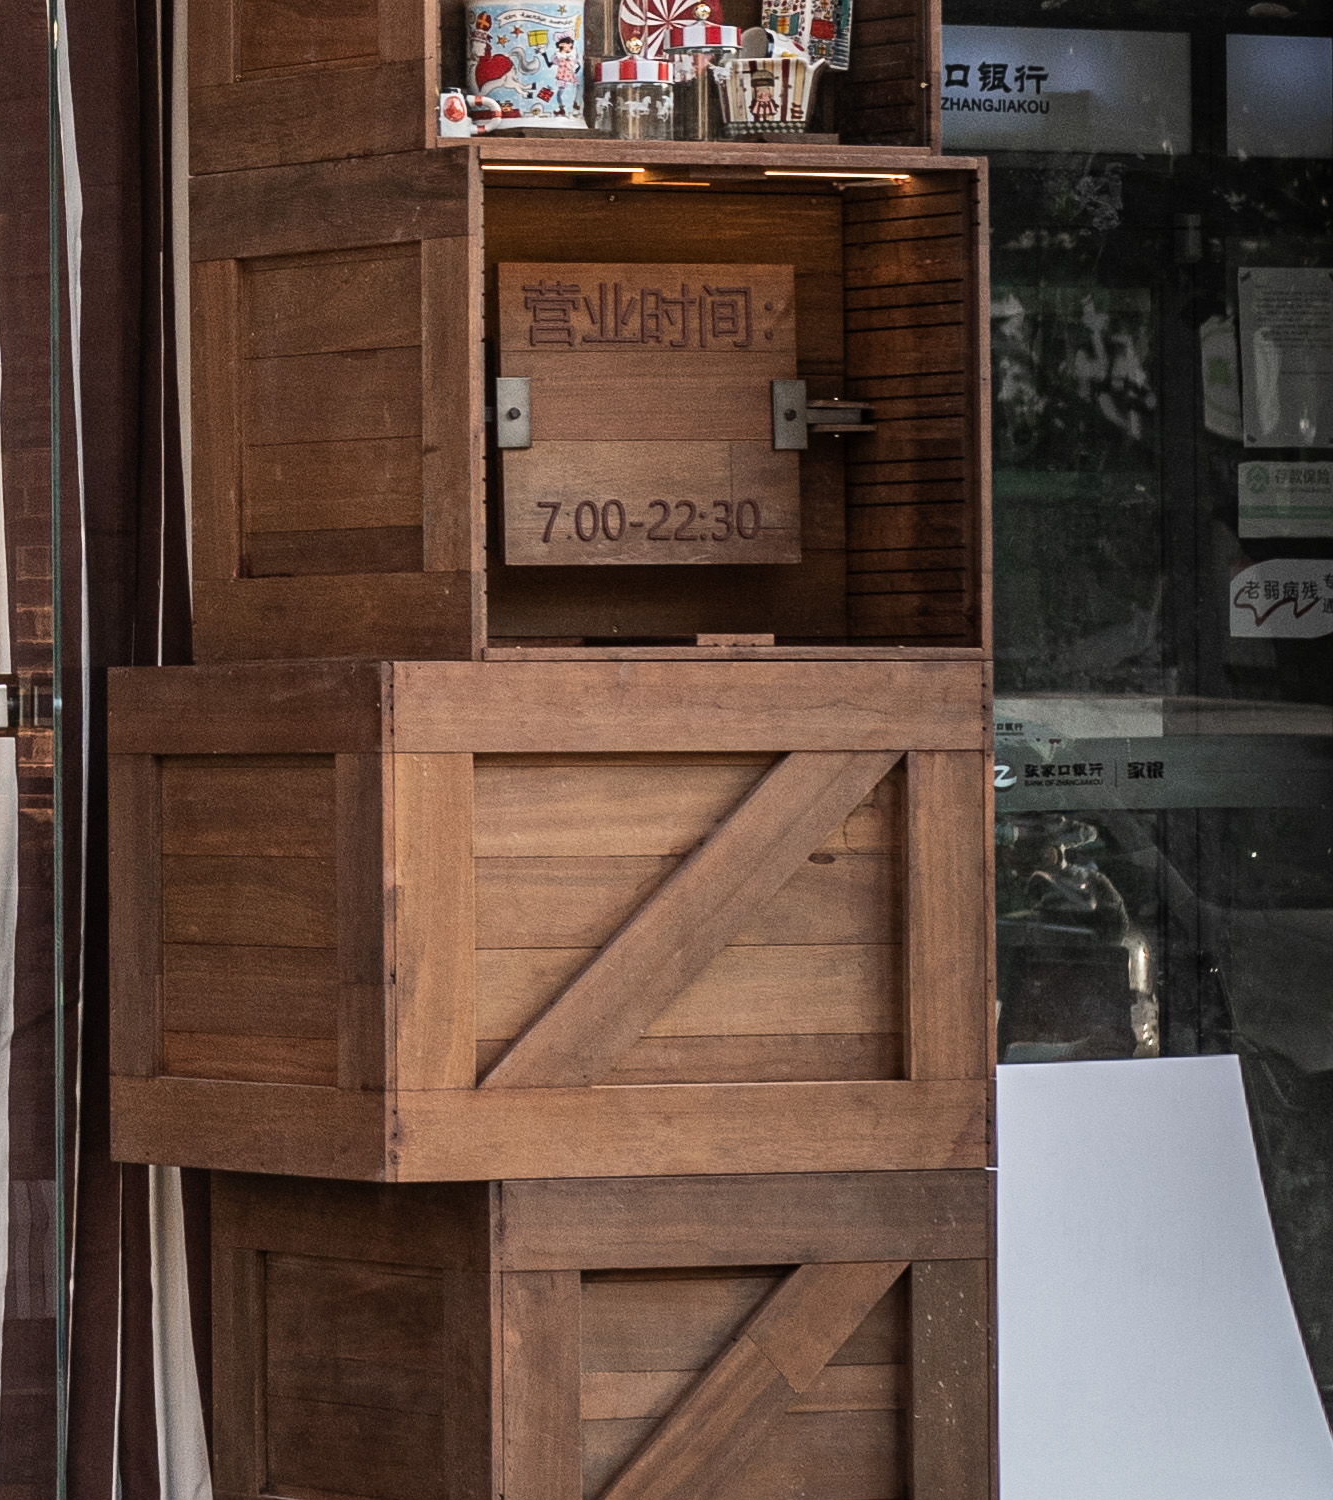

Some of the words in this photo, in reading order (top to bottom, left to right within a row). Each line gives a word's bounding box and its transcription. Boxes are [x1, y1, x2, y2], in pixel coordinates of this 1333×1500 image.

[944, 61, 1050, 95] 口银行
[941, 97, 1050, 115] ZHANGJIAKOU
[536, 498, 762, 544] 7:00-22:30
[1244, 580, 1318, 601] 老弱病残
